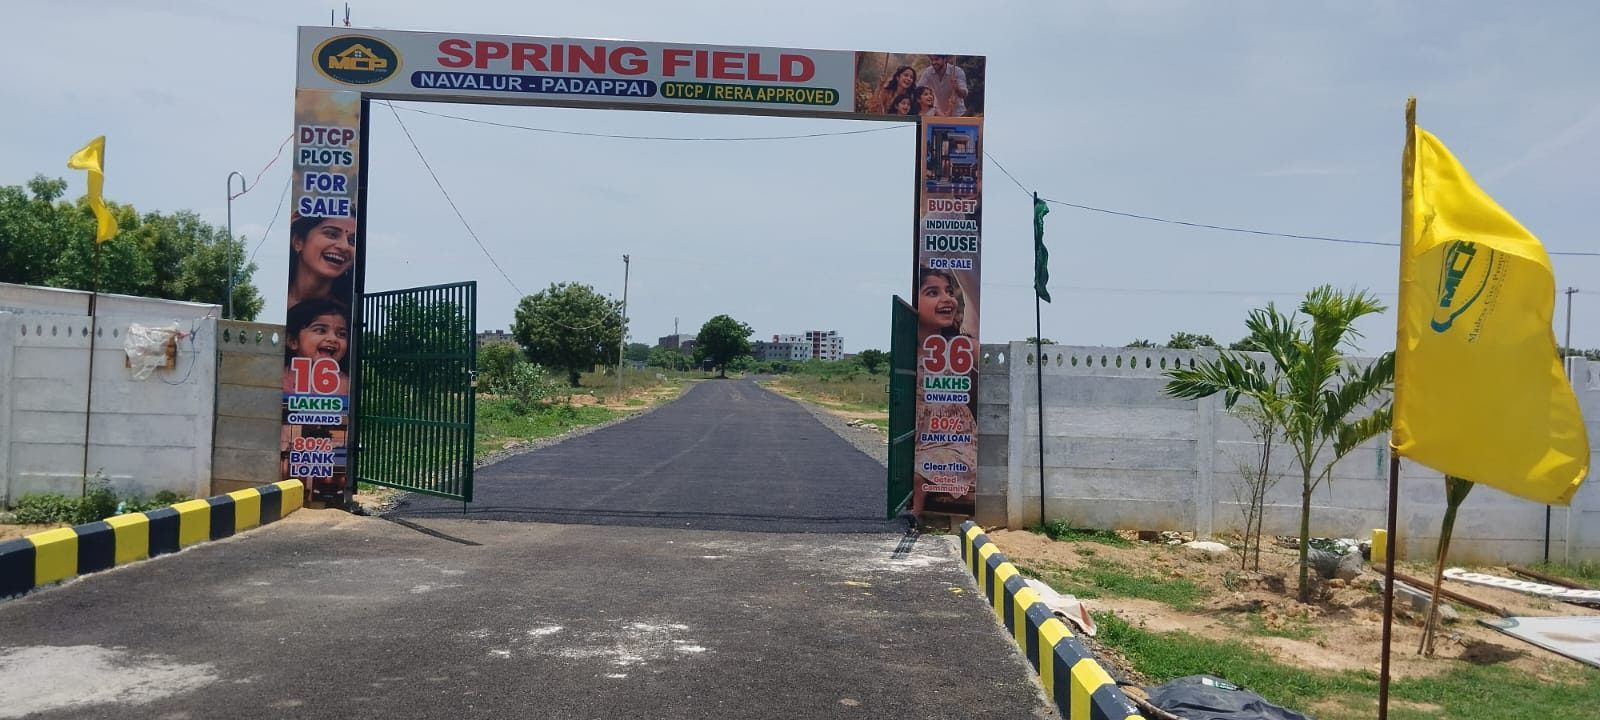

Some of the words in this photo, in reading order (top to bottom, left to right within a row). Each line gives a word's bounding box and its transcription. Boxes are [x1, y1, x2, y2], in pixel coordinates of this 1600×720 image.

[328, 55, 387, 71] MCP
[437, 38, 649, 76] SPRING
[661, 48, 815, 83] FIELD
[420, 73, 523, 91] NAVALUR
[541, 79, 649, 97] PADAPPAI
[665, 84, 703, 99] DTCP
[714, 86, 755, 101] RERA
[757, 88, 835, 104] APPROVED
[299, 126, 355, 146] DTCP
[300, 149, 353, 166] PLOTS
[305, 173, 346, 191] FOR
[299, 198, 349, 217] SALE
[928, 199, 976, 213] BUDGET
[926, 220, 977, 231] INDIVIDUAL
[926, 236, 976, 252] HOUSE
[930, 258, 948, 269] FOR
[950, 259, 972, 269] SALE
[924, 336, 973, 374] 36
[291, 357, 340, 394] 16
[925, 377, 970, 390] LAKHS
[289, 397, 342, 411] LAKHS
[926, 393, 968, 403] ONWARDS
[289, 414, 341, 424] ONWARDS
[930, 417, 962, 431] 80%
[294, 438, 332, 452] 80%
[922, 434, 947, 442] BANK
[947, 434, 971, 443] LOAN
[290, 452, 334, 464] BANK
[291, 465, 333, 477] LOAN
[923, 462, 948, 472] Clear
[948, 463, 967, 472] Title
[933, 476, 957, 484] Gated
[922, 484, 969, 495] Community
